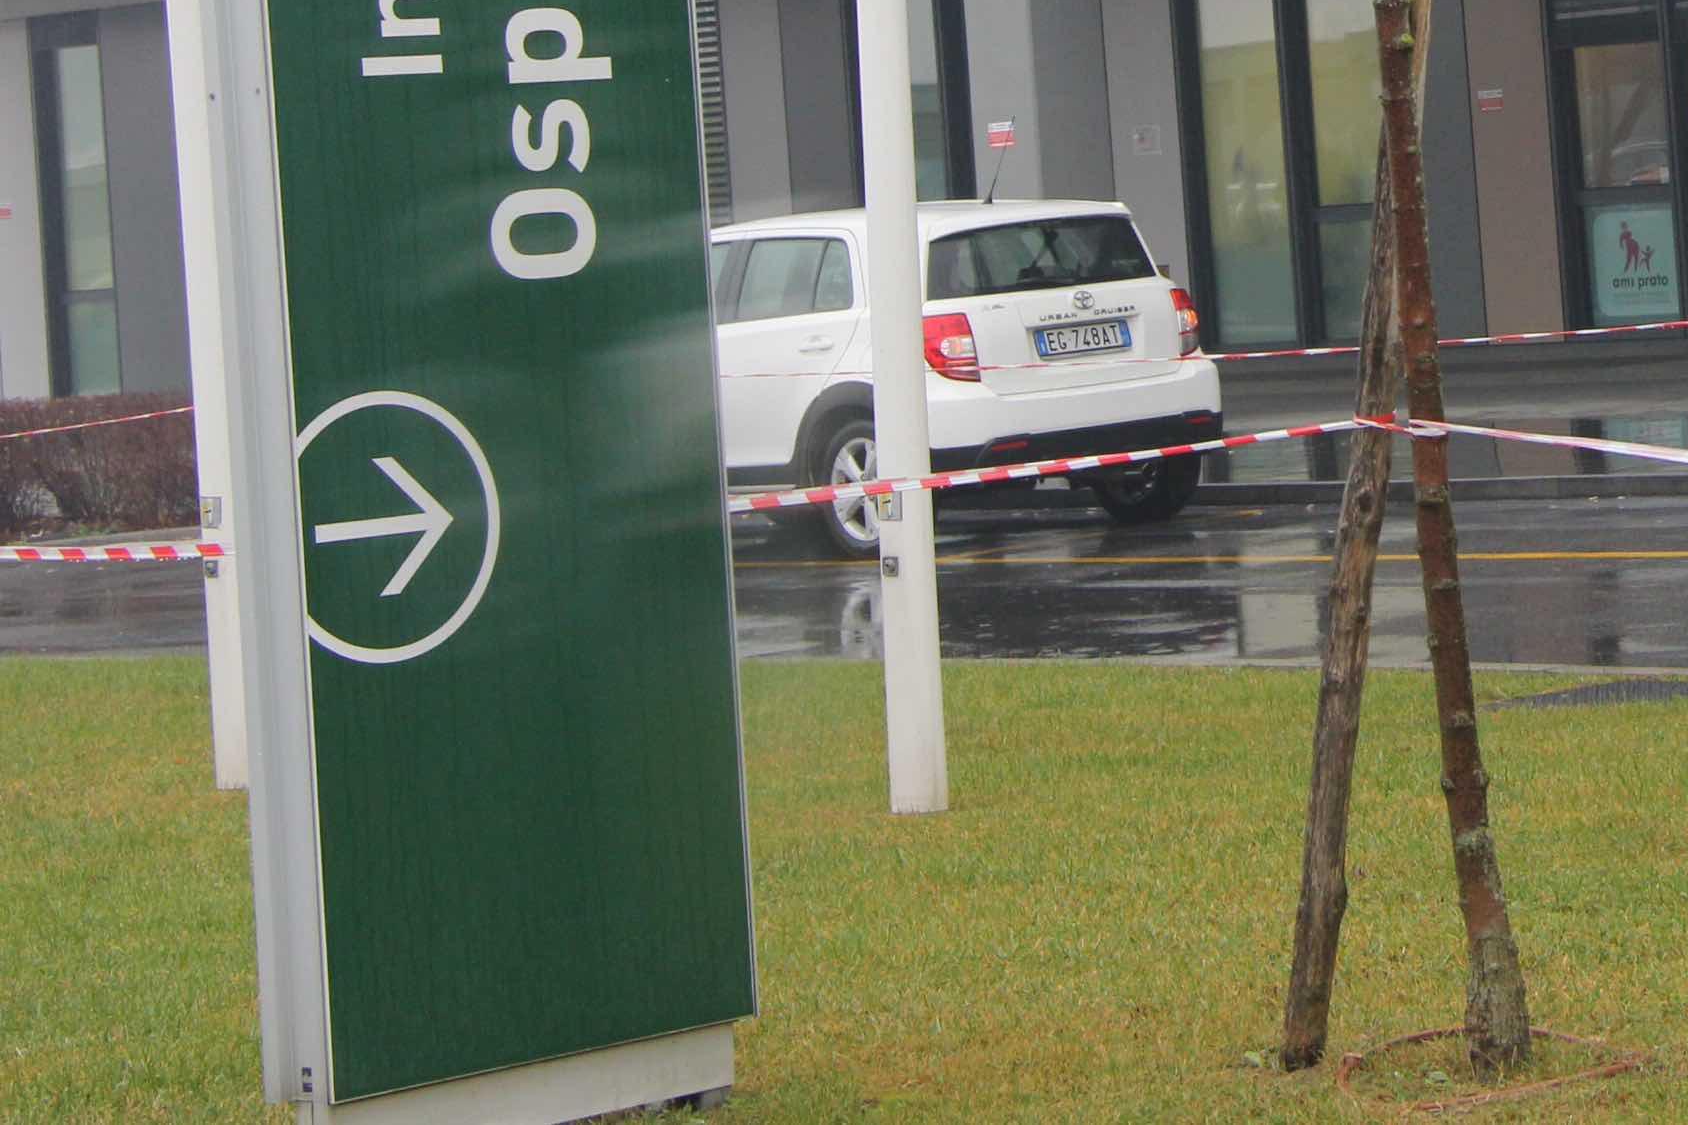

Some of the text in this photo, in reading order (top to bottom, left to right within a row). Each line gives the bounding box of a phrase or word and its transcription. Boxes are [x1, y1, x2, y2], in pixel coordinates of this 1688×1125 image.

[1612, 273, 1669, 291] ami prato
[1039, 305, 1136, 322] URBAN CRUISER
